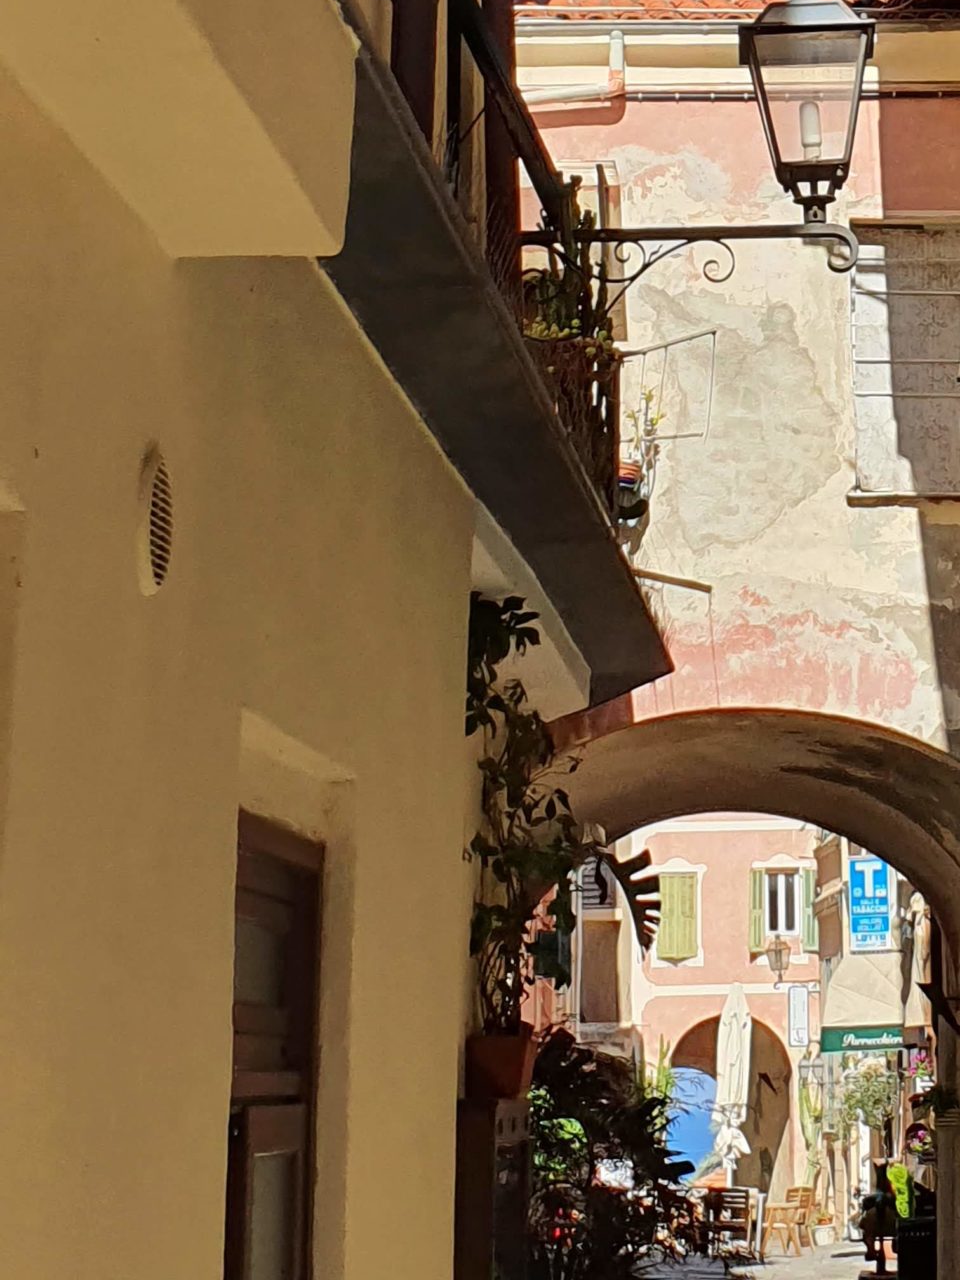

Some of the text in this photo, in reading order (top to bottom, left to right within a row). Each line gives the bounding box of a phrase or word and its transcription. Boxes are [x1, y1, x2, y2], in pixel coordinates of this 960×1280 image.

[855, 862, 882, 898] T
[852, 905, 888, 914] TABACCHI
[855, 934, 886, 942] LOTTO
